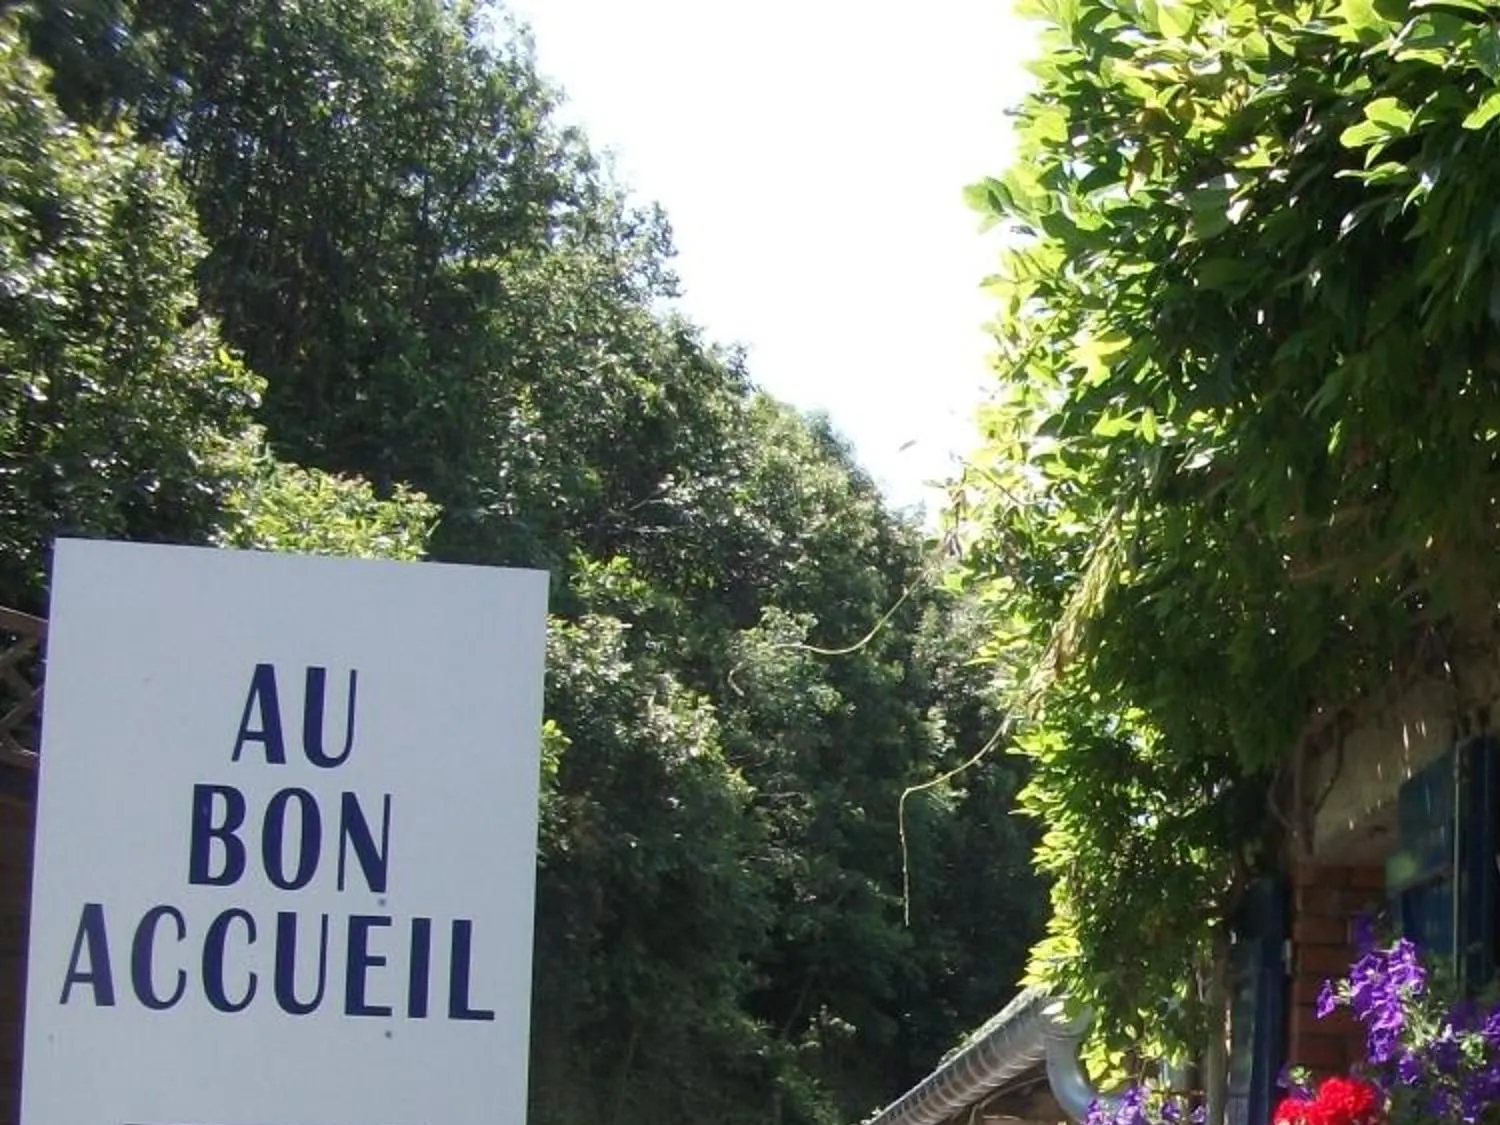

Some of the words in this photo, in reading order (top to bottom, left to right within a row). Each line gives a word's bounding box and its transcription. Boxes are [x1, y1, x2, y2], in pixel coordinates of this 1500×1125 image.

[231, 663, 358, 769] AU
[187, 783, 392, 894] BON
[59, 902, 496, 1022] ACCUEIL
